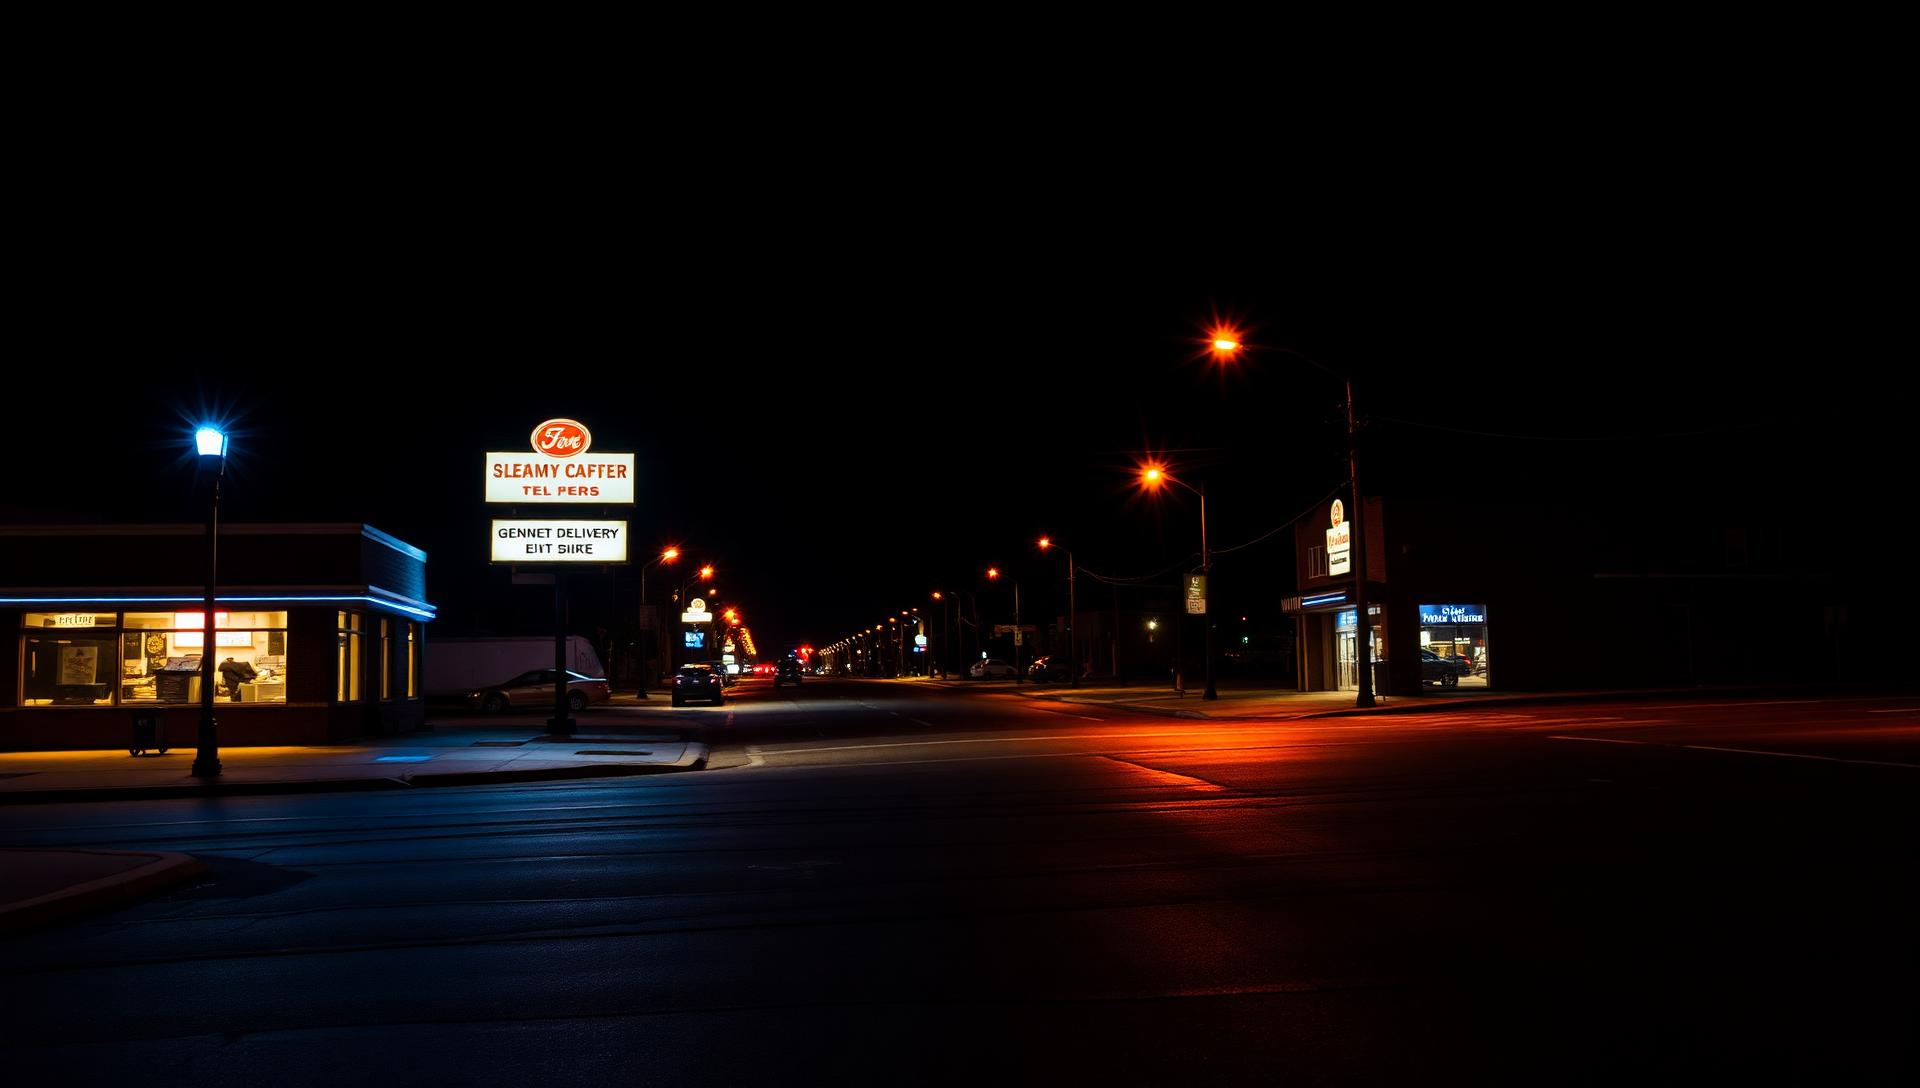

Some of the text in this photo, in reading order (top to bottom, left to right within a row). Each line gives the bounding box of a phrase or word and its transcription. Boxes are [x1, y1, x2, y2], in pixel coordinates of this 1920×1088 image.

[493, 463, 560, 478] SLEAMY
[522, 486, 600, 497] TEL PERS
[498, 528, 619, 539] GENNET DELIVERY
